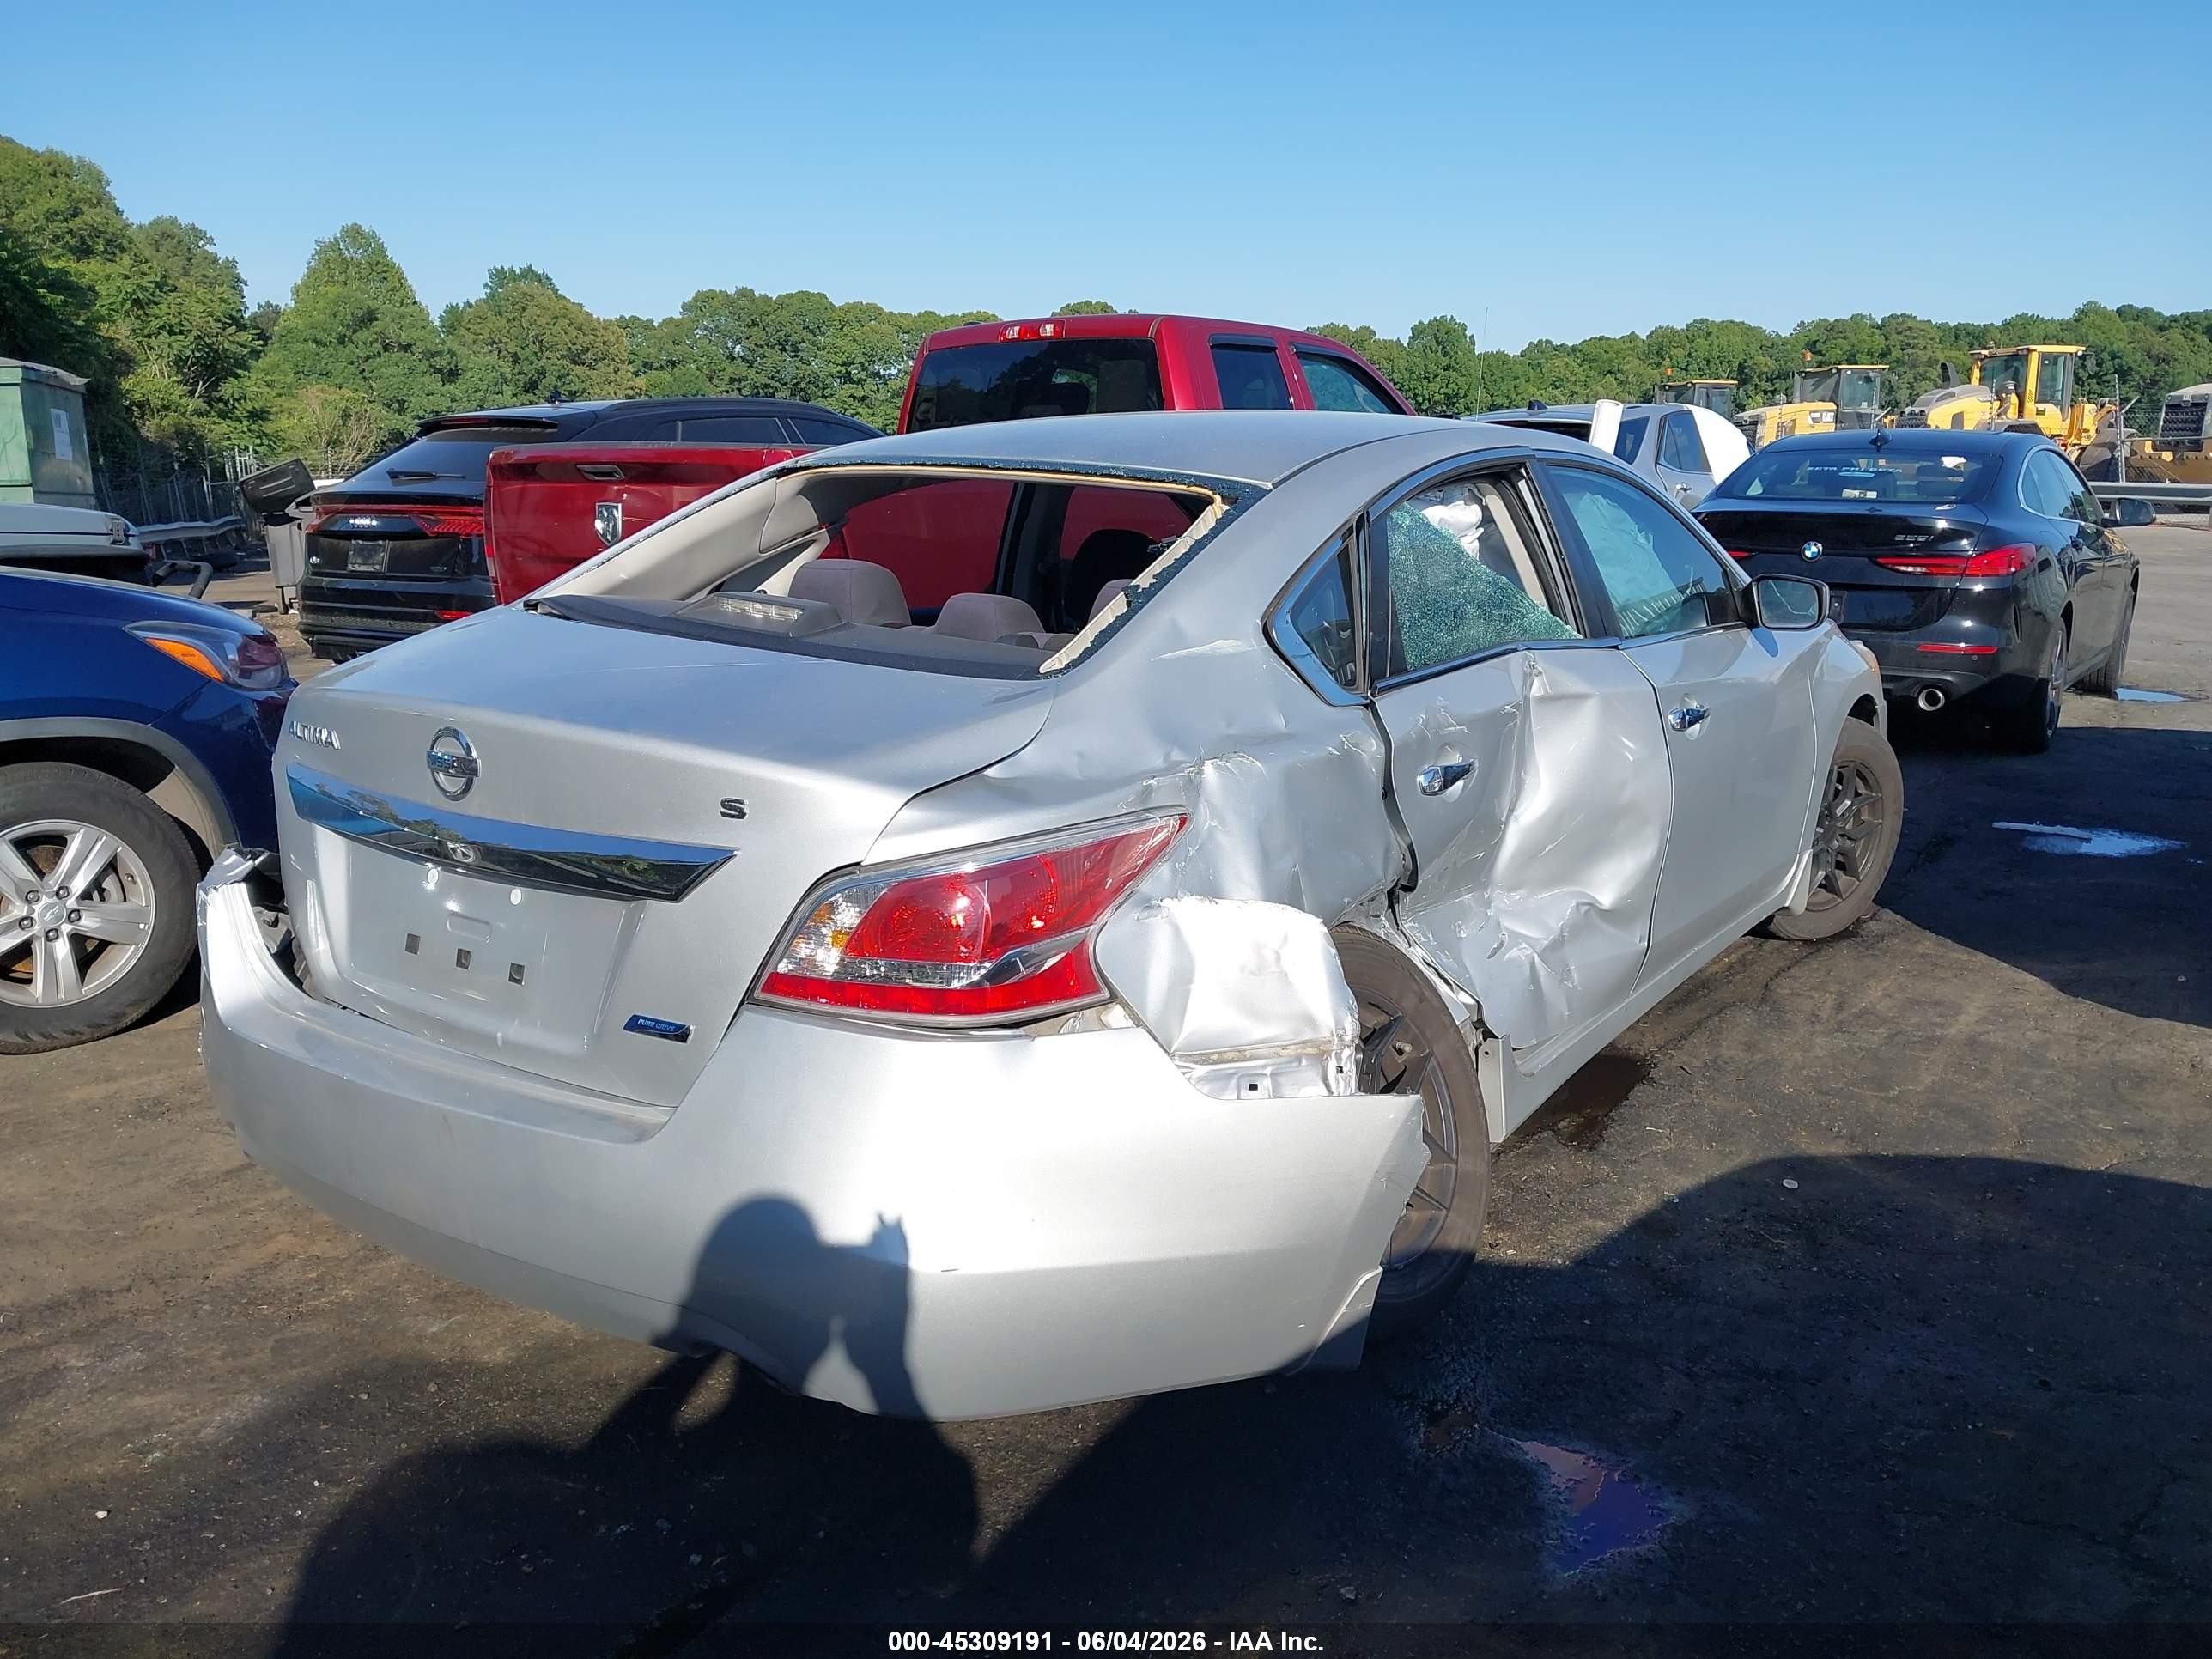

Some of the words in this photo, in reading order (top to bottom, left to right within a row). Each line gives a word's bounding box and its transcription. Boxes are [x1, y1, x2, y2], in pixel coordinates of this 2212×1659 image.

[289, 720, 341, 750] ALTIMA
[720, 796, 748, 821] S
[637, 1018, 655, 1028] PURE
